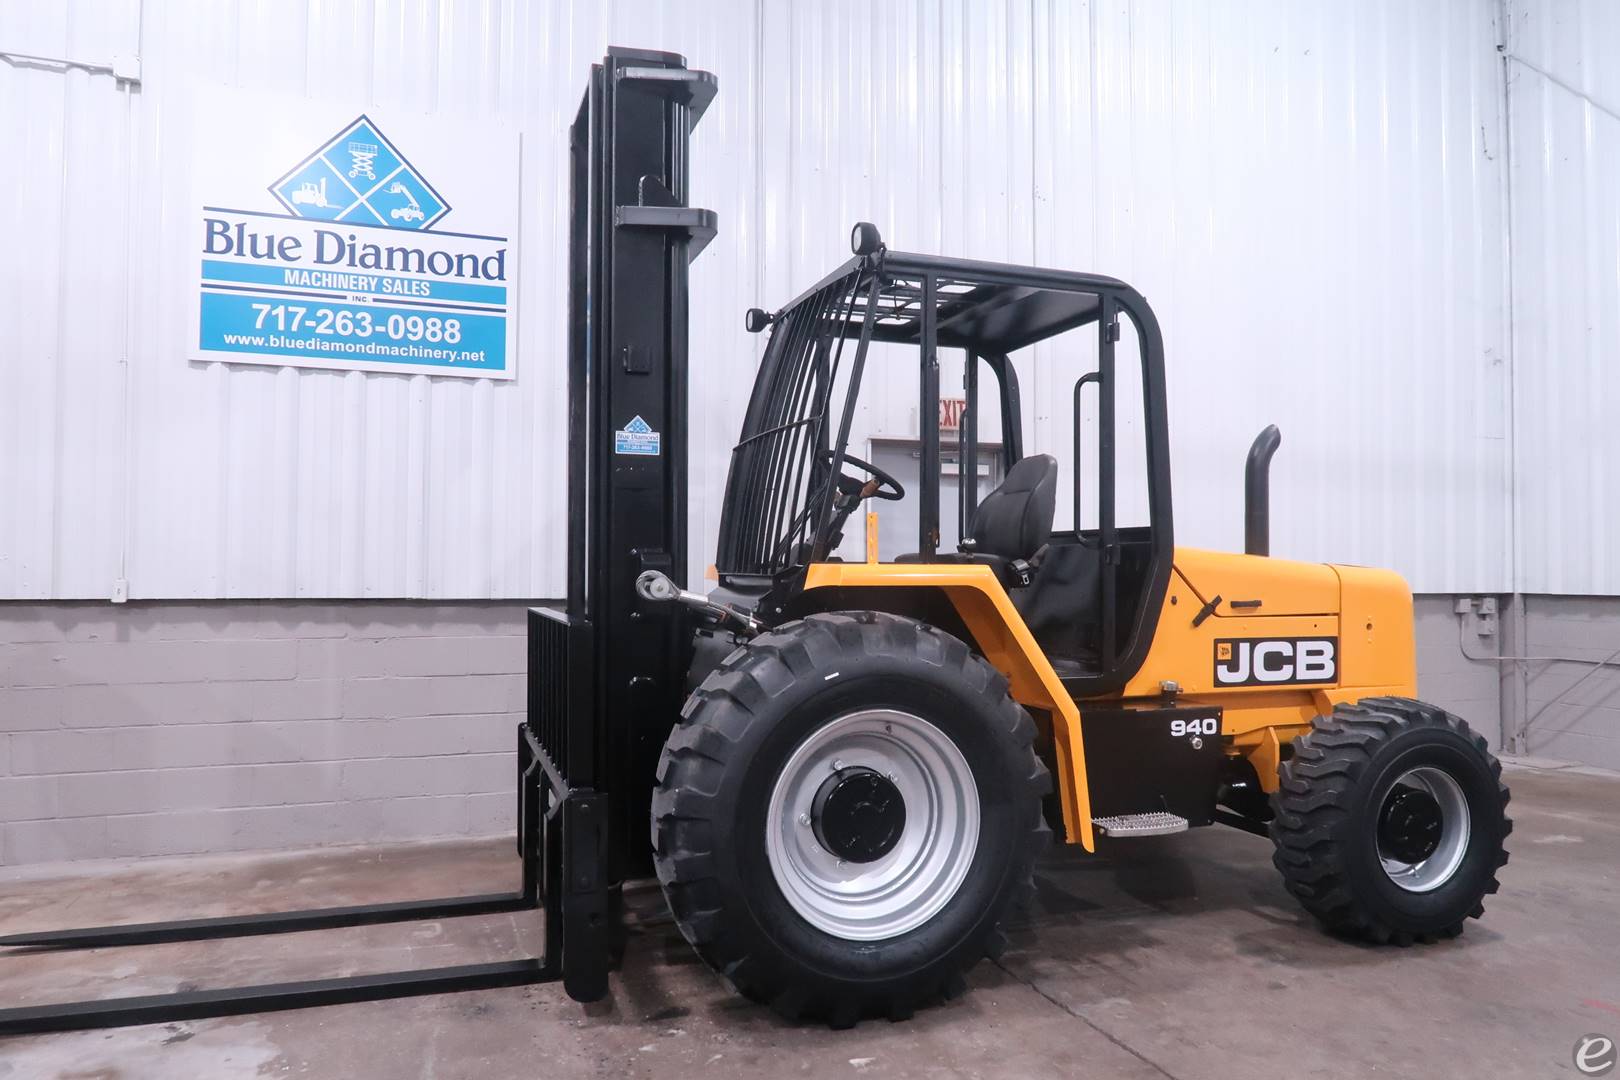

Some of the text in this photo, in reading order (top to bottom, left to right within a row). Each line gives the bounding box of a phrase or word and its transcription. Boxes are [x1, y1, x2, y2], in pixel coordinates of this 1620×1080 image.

[203, 217, 507, 281] Blue Diamond
[284, 269, 430, 296] MACHINERY SALES
[252, 303, 462, 344] 717-263-0988
[224, 333, 485, 362] www.bluediamondmachinery.net
[1217, 641, 1335, 683] JCB
[1170, 718, 1217, 737] 940
